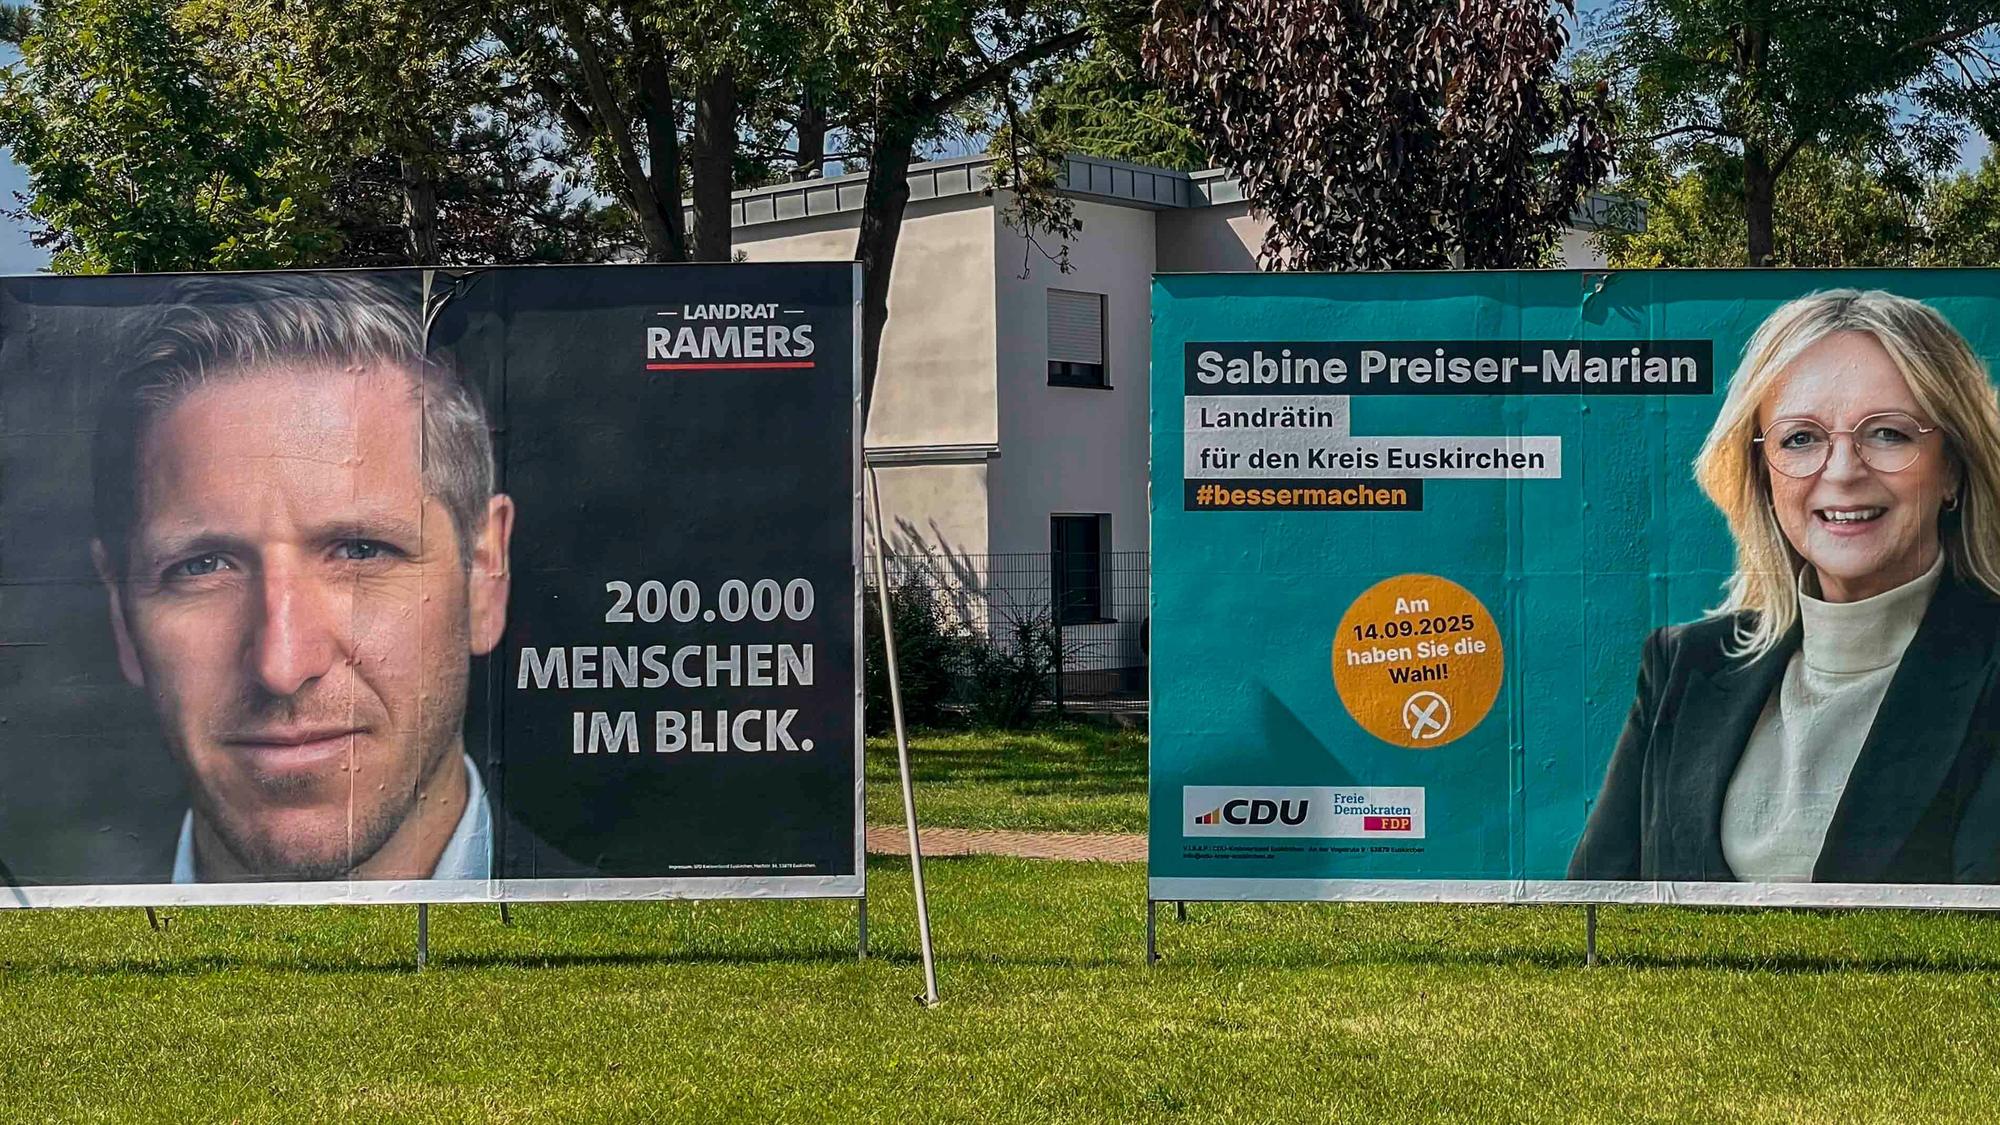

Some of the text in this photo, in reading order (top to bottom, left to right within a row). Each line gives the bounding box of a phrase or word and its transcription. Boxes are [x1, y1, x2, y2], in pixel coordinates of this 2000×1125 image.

[684, 304, 778, 320] LANDRAT
[647, 325, 815, 359] RAMERS
[1197, 348, 1697, 384] Sabine Preiser-Marian
[1201, 406, 1333, 428] Landrätin
[1200, 447, 1545, 470] für den Kreis Euskirchen
[1196, 485, 1407, 505] #bessermachen
[605, 578, 815, 623] 200.000
[1395, 598, 1429, 614] Am
[1353, 615, 1474, 641] 14.09.2025
[1346, 637, 1487, 666] haben Sie die
[517, 643, 814, 689] MENSCHEN
[1388, 663, 1449, 684] Wahl!
[573, 709, 814, 754] IM BLICK.
[1334, 793, 1365, 804] Freie
[1334, 804, 1411, 816] Demokraten
[1222, 799, 1309, 825] CDU
[1381, 817, 1409, 830] FDP
